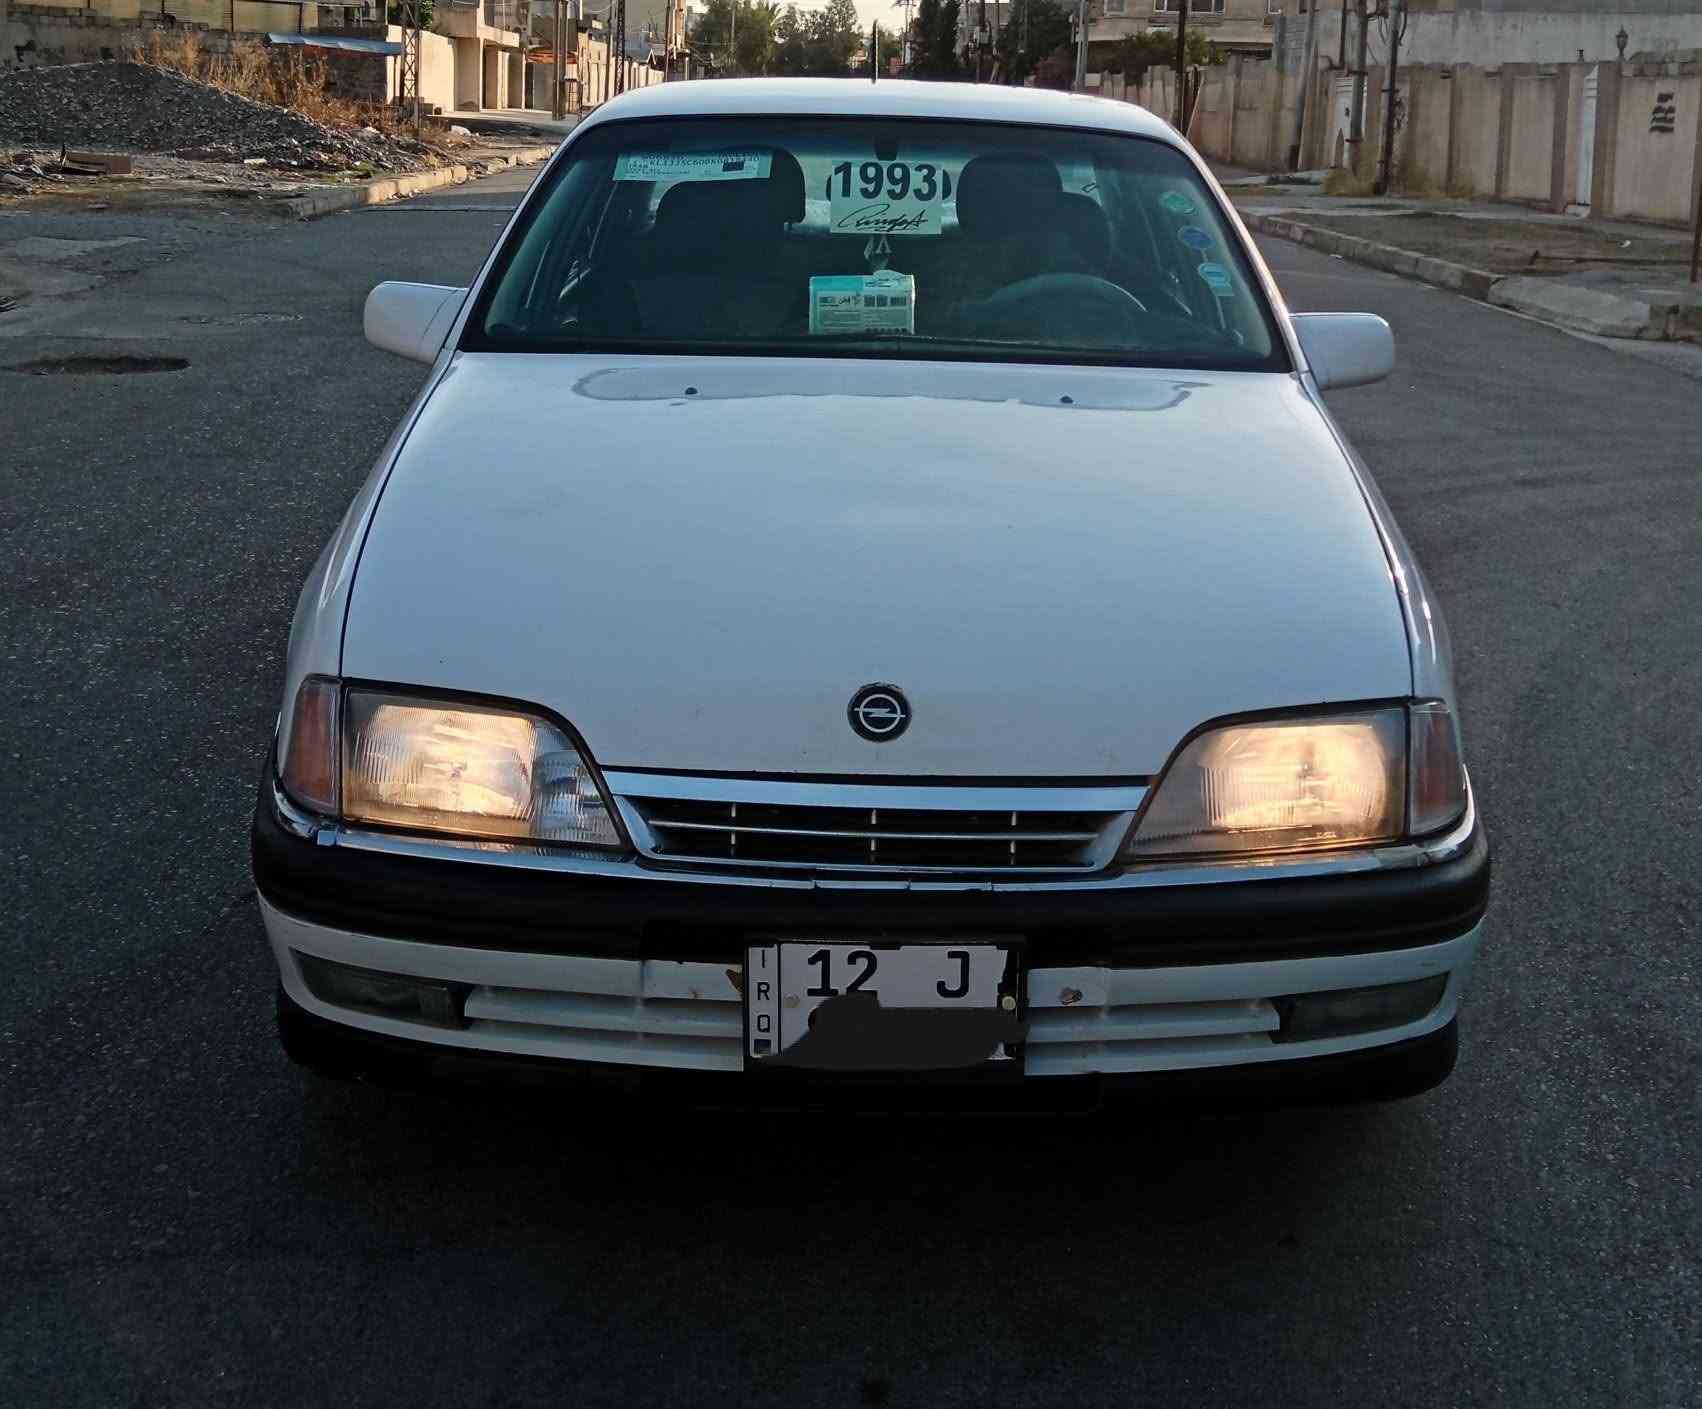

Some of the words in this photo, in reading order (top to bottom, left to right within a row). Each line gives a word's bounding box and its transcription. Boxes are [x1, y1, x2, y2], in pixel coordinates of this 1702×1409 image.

[834, 161, 937, 202] 1993
[806, 949, 879, 998] 12
[936, 950, 971, 999] J
